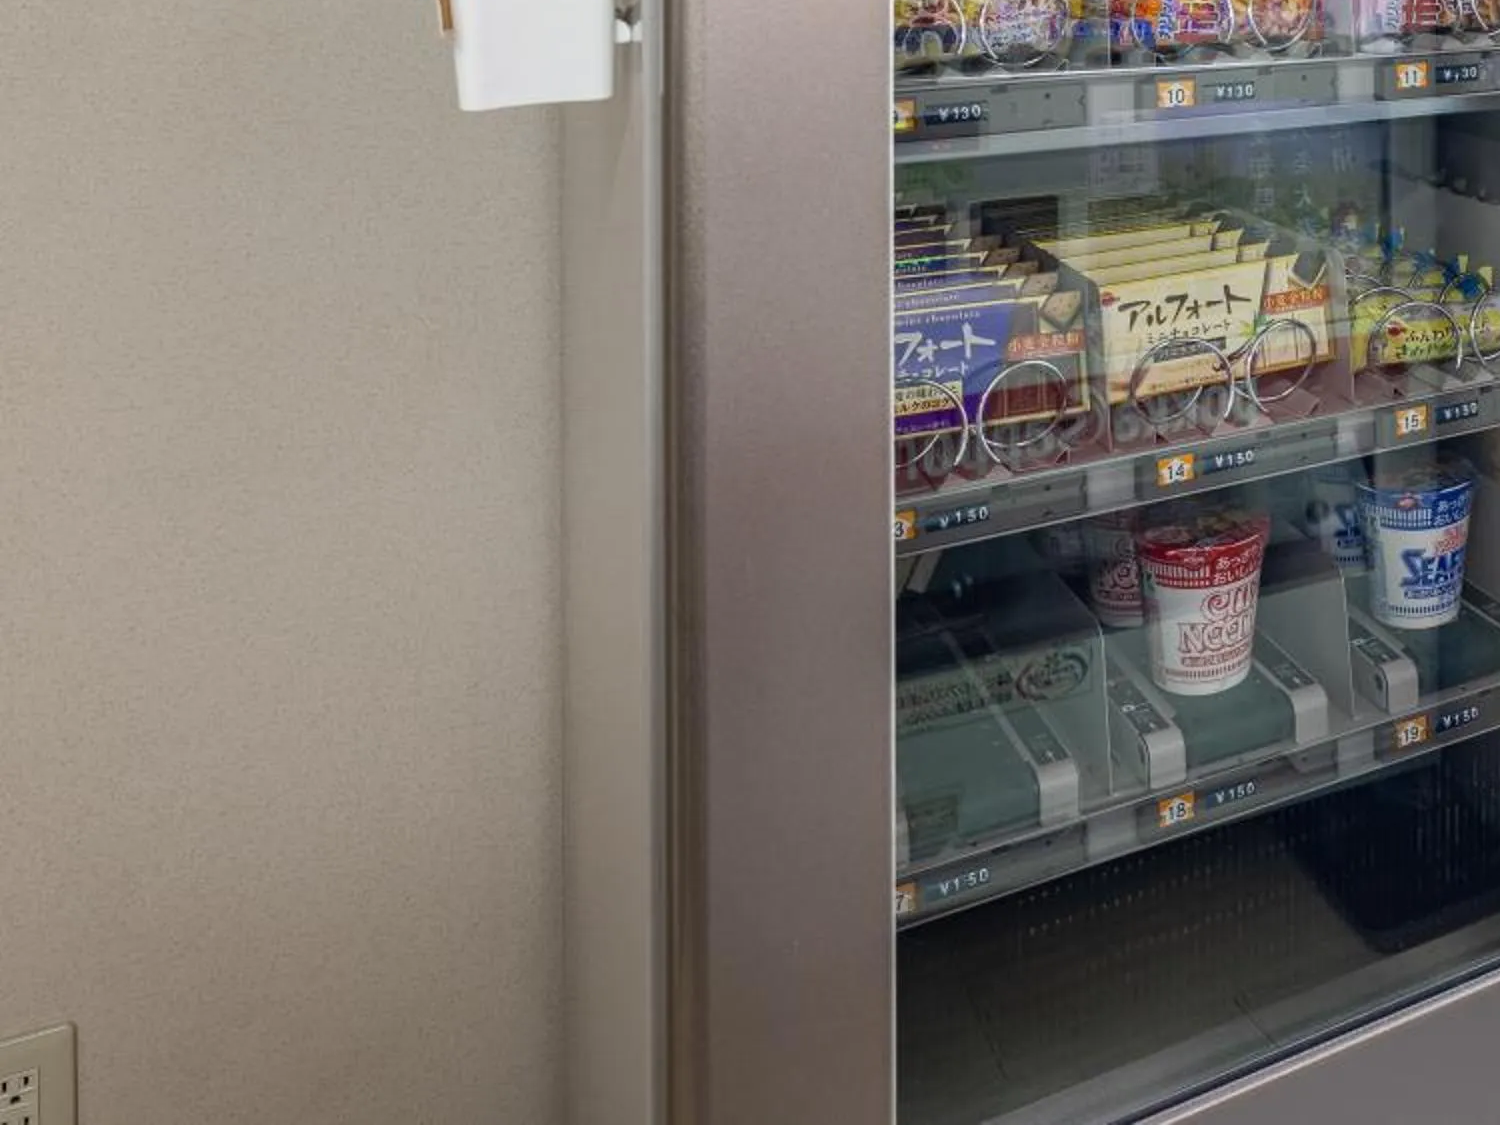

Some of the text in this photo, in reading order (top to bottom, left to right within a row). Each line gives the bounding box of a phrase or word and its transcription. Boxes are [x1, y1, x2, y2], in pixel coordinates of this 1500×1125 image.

[1404, 69, 1420, 89] 11
[1167, 86, 1186, 104] 10
[1216, 81, 1254, 98] ¥130
[938, 104, 983, 122] ¥130
[1118, 284, 1252, 332] アルフォート
[1402, 412, 1420, 431] 15
[1216, 450, 1254, 468] ¥150
[1168, 461, 1186, 481] 14
[938, 506, 989, 527] ¥150
[1402, 726, 1419, 744] 19
[1216, 781, 1256, 803] ¥150
[1169, 802, 1187, 822] 18
[938, 867, 990, 896] ¥150
